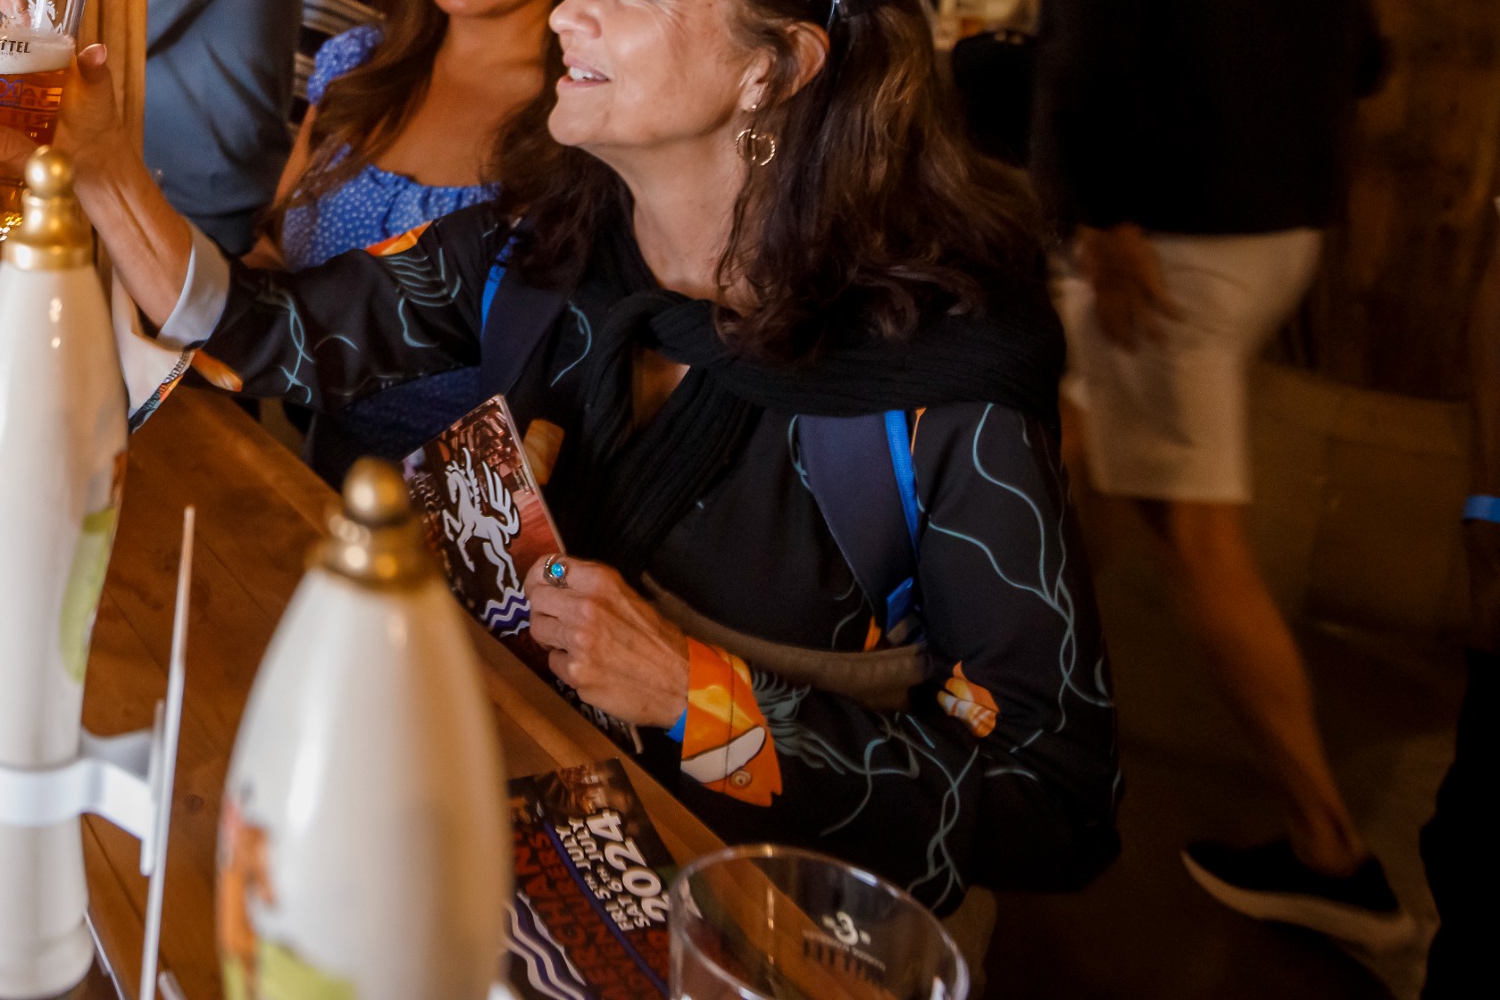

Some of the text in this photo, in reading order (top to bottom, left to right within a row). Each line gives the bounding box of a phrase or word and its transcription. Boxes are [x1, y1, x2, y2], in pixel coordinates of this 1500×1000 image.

[555, 824, 591, 870] JULY
[568, 815, 604, 862] JULY
[586, 808, 670, 922] 2024
[605, 901, 635, 931] FRI
[617, 895, 650, 927] SAT
